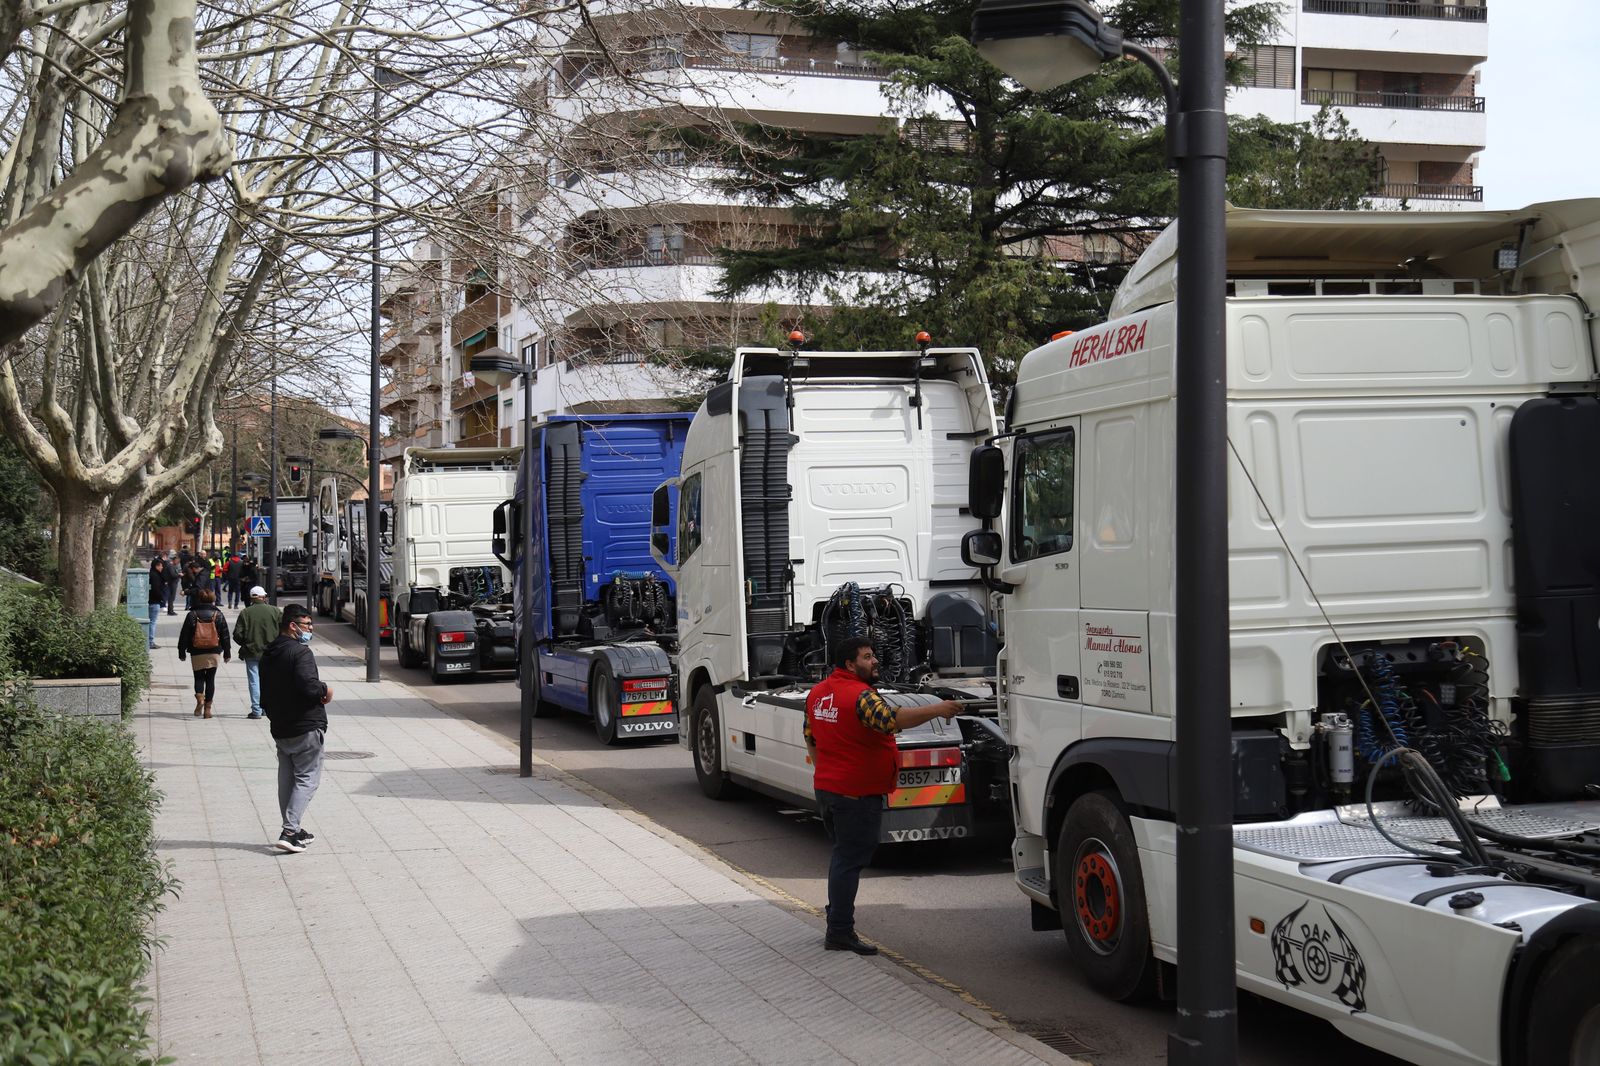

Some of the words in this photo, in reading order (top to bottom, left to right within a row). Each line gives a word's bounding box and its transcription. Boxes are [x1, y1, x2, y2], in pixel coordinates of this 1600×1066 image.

[1069, 319, 1148, 368] HERALBRA
[818, 481, 897, 496] VOLVO
[1055, 562, 1069, 570] 530
[1084, 637, 1113, 652] Manuel
[1113, 639, 1143, 654] Alonso
[446, 662, 471, 670] DAF
[627, 692, 647, 701] 7676
[622, 721, 674, 732] VOLVO
[899, 771, 930, 785] 9657
[935, 769, 958, 783] JLY
[888, 826, 967, 842] VOLVO
[1300, 923, 1331, 943] DAF
